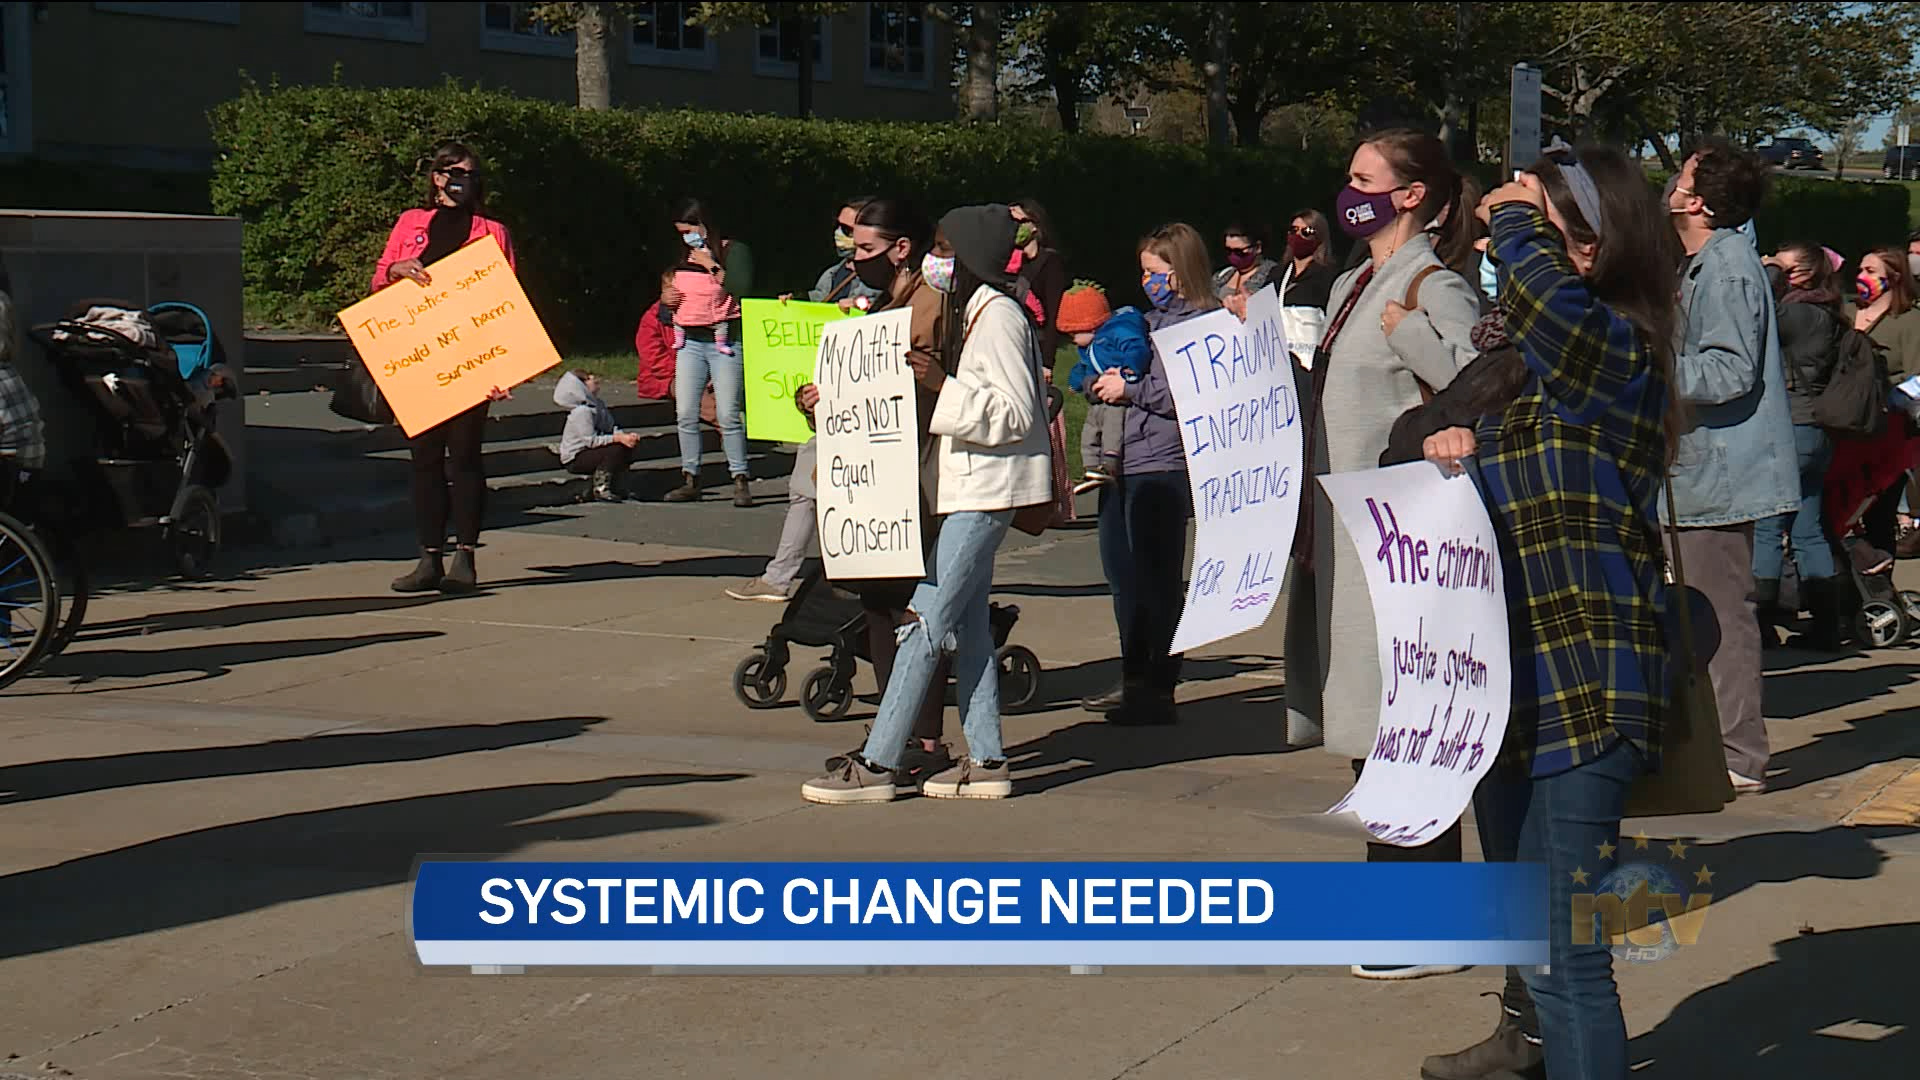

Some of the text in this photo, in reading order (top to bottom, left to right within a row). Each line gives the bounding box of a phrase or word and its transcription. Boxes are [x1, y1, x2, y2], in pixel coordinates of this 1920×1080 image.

[357, 260, 503, 340] The justice system
[384, 300, 515, 377] should NOT harm
[818, 322, 902, 399] My Outfit
[1176, 316, 1289, 395] TRAUMA
[826, 395, 903, 436] does NOT
[1185, 384, 1296, 456] INFORMED
[831, 455, 876, 504] equal
[1199, 461, 1290, 522] TRAINING
[823, 506, 913, 558] Consent
[1436, 530, 1496, 597] criminal
[1192, 551, 1274, 605] FOR ALL
[1388, 616, 1488, 719] justice system
[1372, 703, 1491, 775] was not built to
